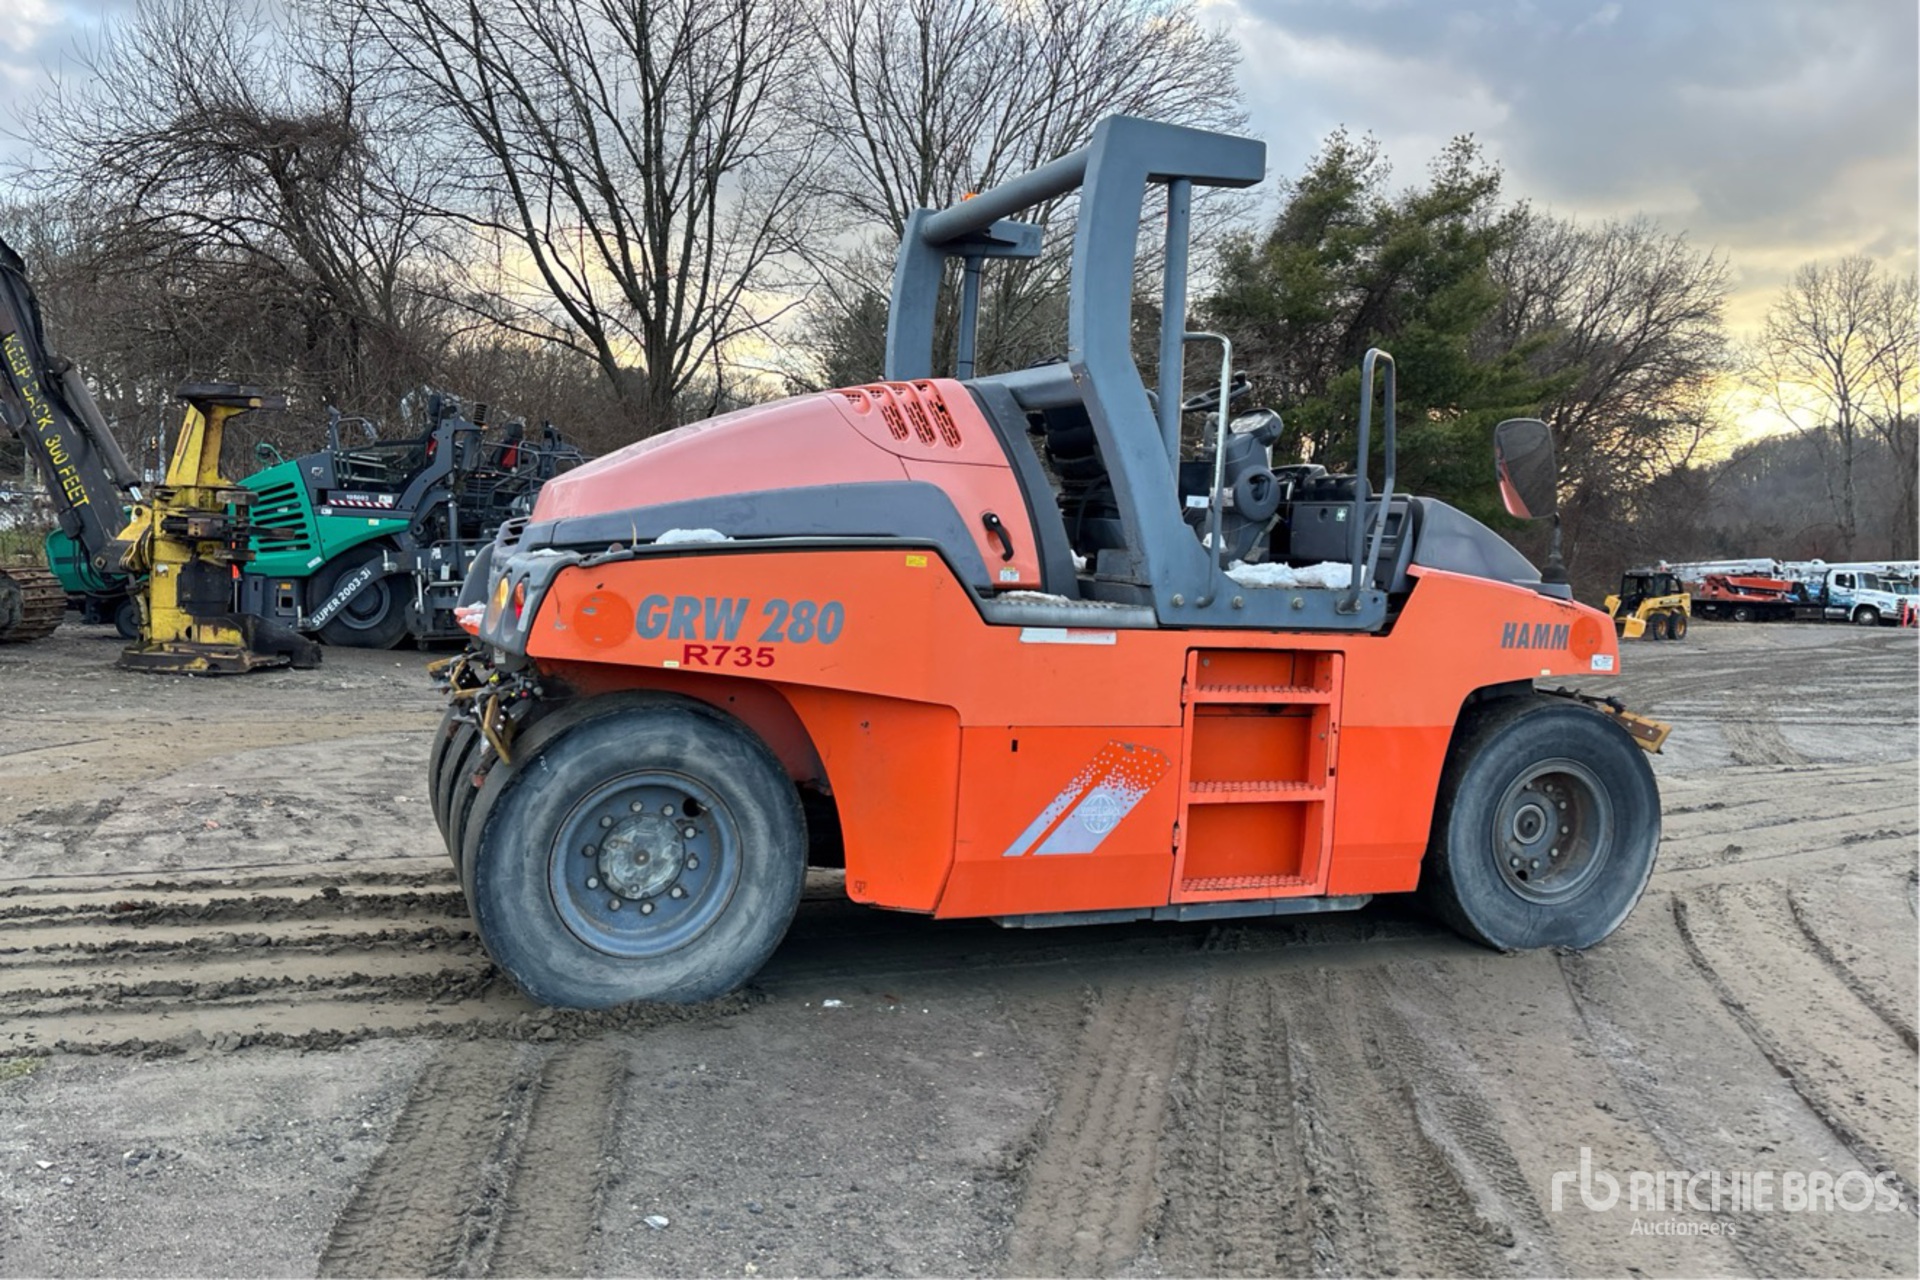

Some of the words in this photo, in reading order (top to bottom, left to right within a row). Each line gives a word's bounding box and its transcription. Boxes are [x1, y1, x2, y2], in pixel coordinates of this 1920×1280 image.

[3, 333, 33, 378] KEEP
[22, 381, 54, 432] BACK
[45, 434, 69, 465] 300
[58, 465, 90, 507] FEET
[312, 598, 341, 626] SUPER
[338, 567, 372, 601] 2003-3i
[635, 594, 750, 641] GRW
[757, 598, 845, 645] 280
[683, 644, 775, 668] R735
[1501, 622, 1570, 650] HAMM
